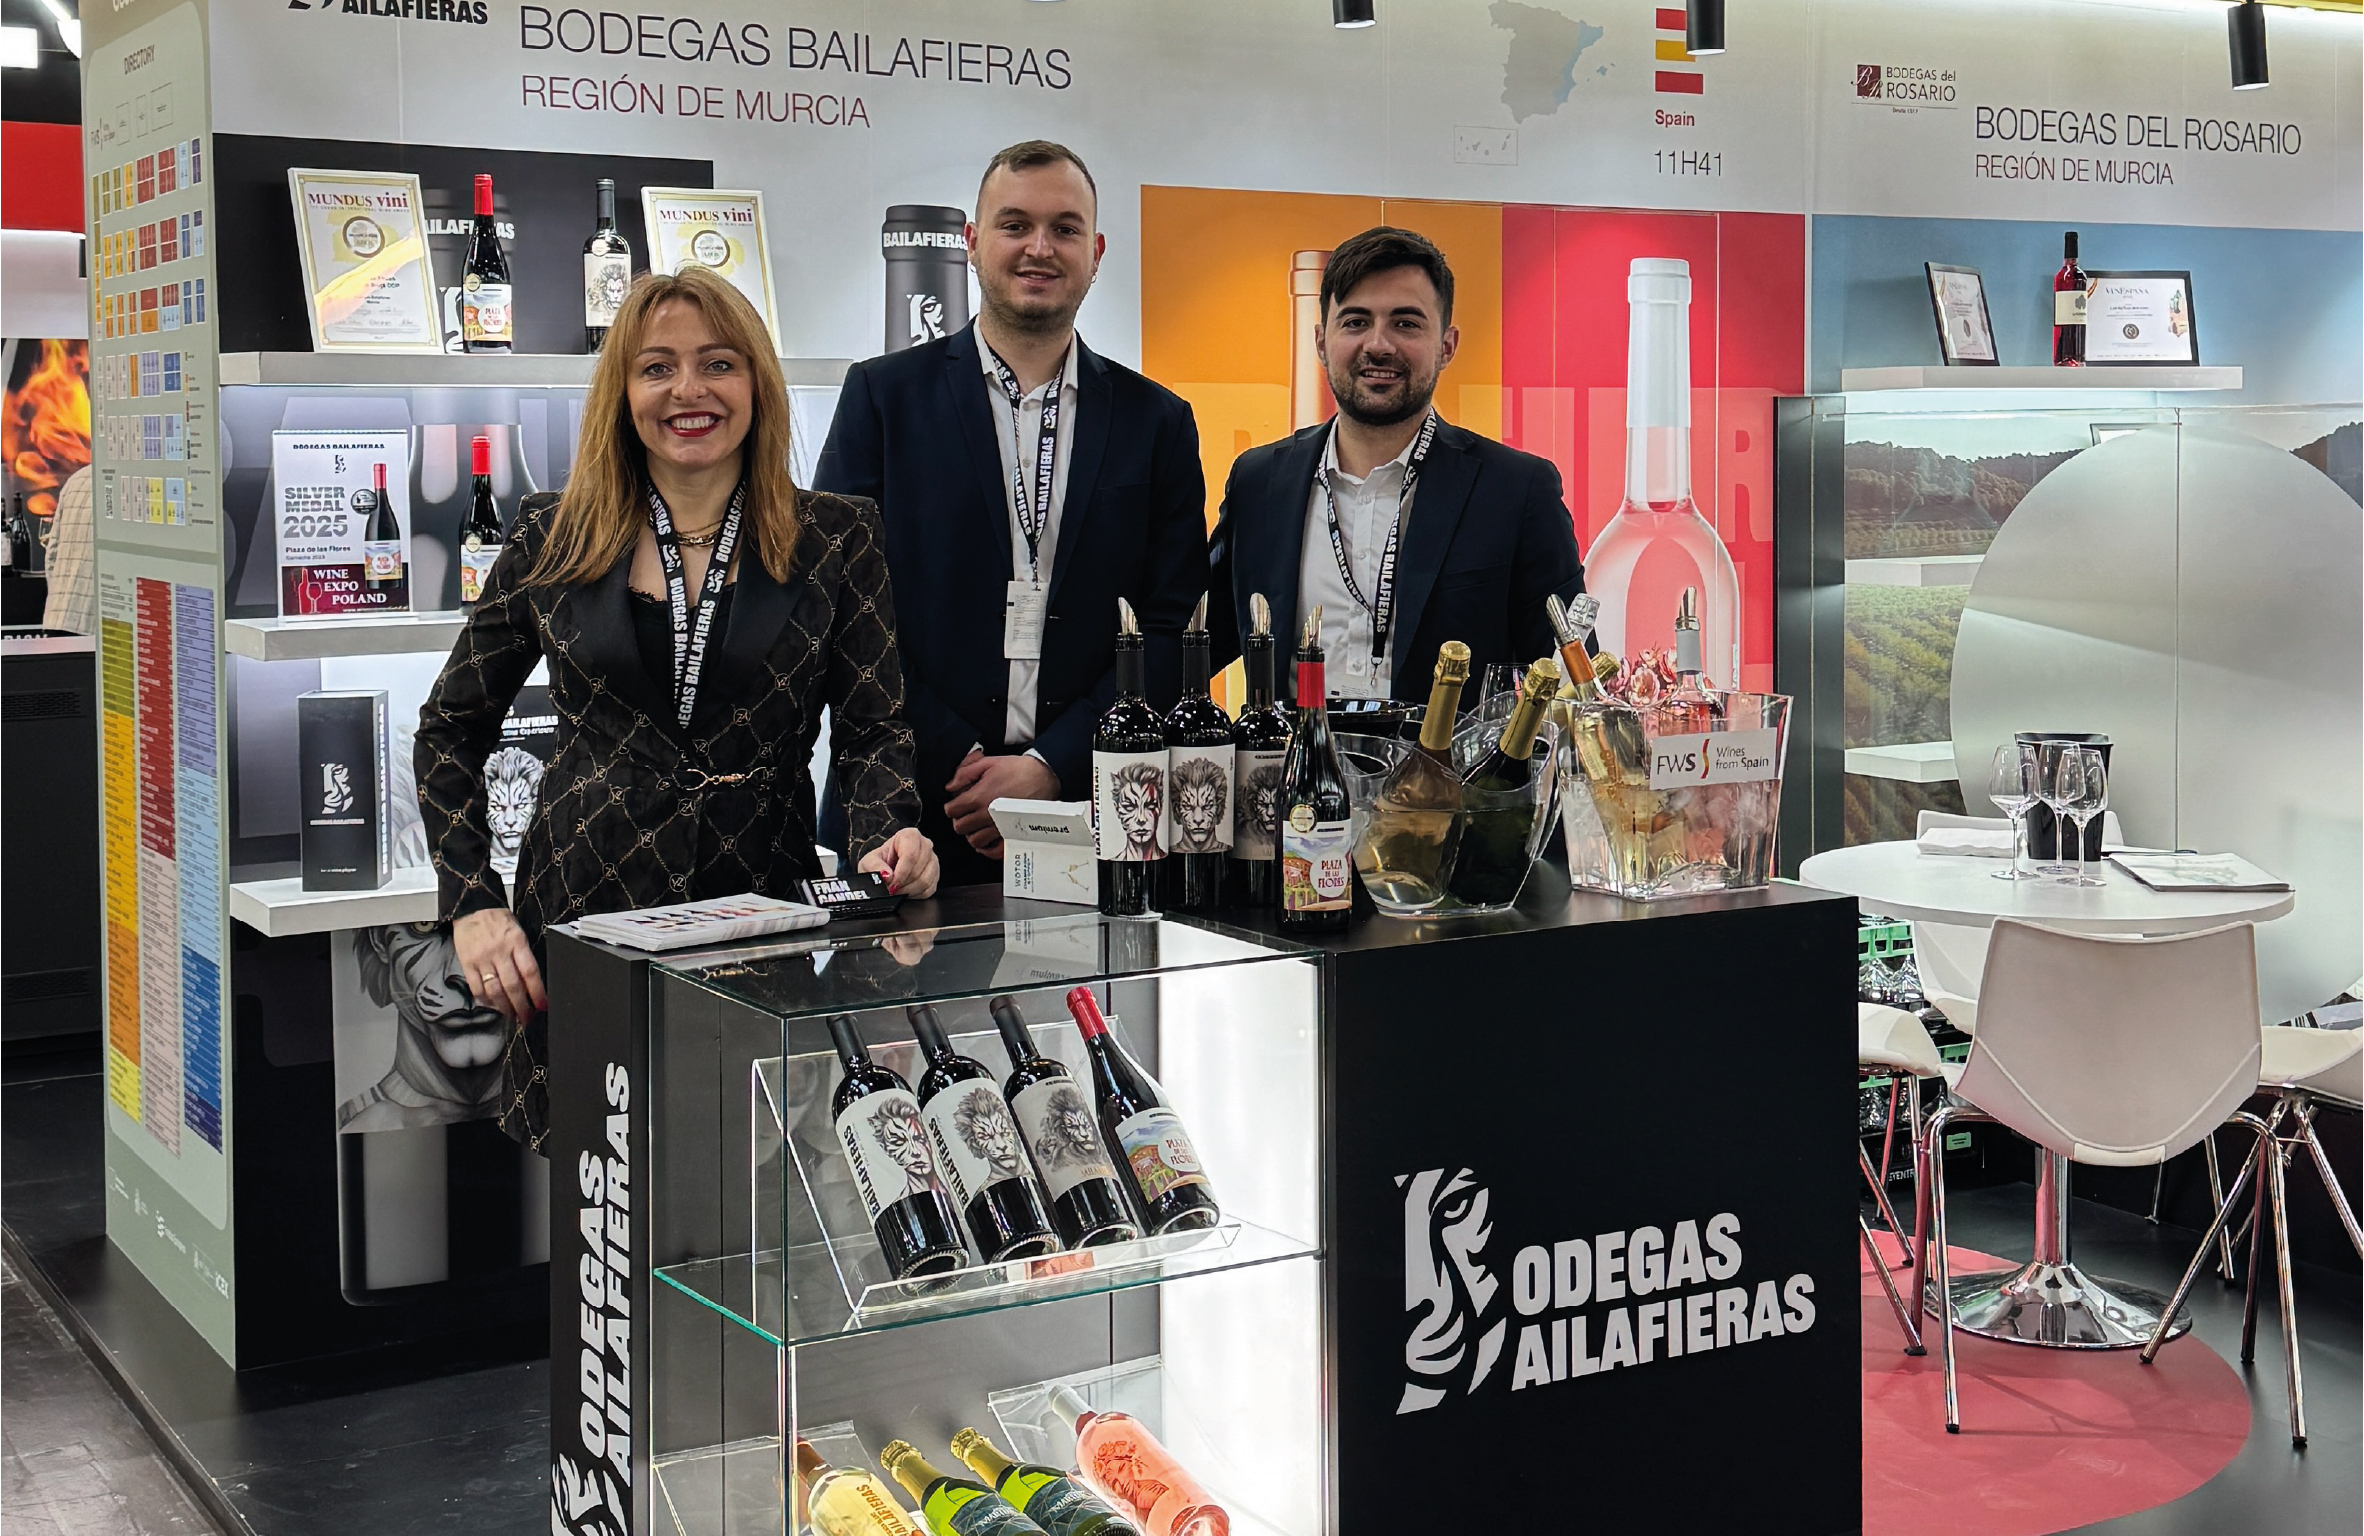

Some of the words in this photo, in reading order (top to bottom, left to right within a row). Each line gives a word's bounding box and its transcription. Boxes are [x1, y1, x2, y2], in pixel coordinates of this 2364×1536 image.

[124, 44, 155, 75] DIRECTORY
[520, 6, 771, 67] BODEGAS
[788, 27, 1072, 90] BAILAFIERAS
[1886, 66, 1937, 80] BODEGAS
[1940, 70, 1956, 81] del
[522, 73, 664, 115] REGIÓN
[678, 85, 725, 119] DE
[736, 89, 871, 129] MURCIA
[1886, 82, 1956, 101] ROSARIO
[1655, 109, 1695, 128] Spain
[1976, 106, 2116, 145] BODEGAS
[2127, 115, 2178, 148] DEL
[2185, 118, 2301, 155] ROSARIO
[1654, 150, 1721, 176] 11H41
[1976, 151, 2055, 181] REGIÓN
[2062, 158, 2090, 182] DE
[2096, 159, 2174, 185] MURCIA
[308, 193, 372, 207] MUNDUS
[376, 192, 409, 208] vini
[660, 209, 719, 222] MUNDUS
[723, 208, 753, 222] vini
[883, 231, 968, 250] BAILAFIERAS
[1037, 436, 1055, 511] BAILAFIERAS
[285, 487, 345, 500] SILVER
[285, 500, 344, 513] MEDAL
[283, 515, 348, 538] 2025
[715, 506, 742, 563] BODEGAS
[313, 569, 349, 580] WINE
[324, 581, 359, 592] EXPO
[332, 593, 387, 605] POLAND
[670, 576, 688, 631] BODEGAS
[1377, 553, 1396, 633] BAILAFIERAS
[685, 599, 716, 685] BAILAFIERAS
[1657, 753, 1696, 775] FWS
[1716, 759, 1738, 769] from
[1741, 756, 1769, 769] Spain
[1717, 747, 1745, 757] Wines
[1321, 859, 1342, 870] PLAZA
[1318, 877, 1344, 888] FLORES
[843, 1125, 881, 1215] BAILAFIERAS
[928, 1117, 969, 1206] BAILAFIERAS
[605, 1061, 630, 1488] AILAFIERAS
[1512, 1212, 1743, 1317] ODEGAS
[579, 1149, 605, 1459] ODEGAS
[1511, 1273, 1816, 1391] AILAFIERAS
[856, 1484, 910, 1536] AILAFIERAS
